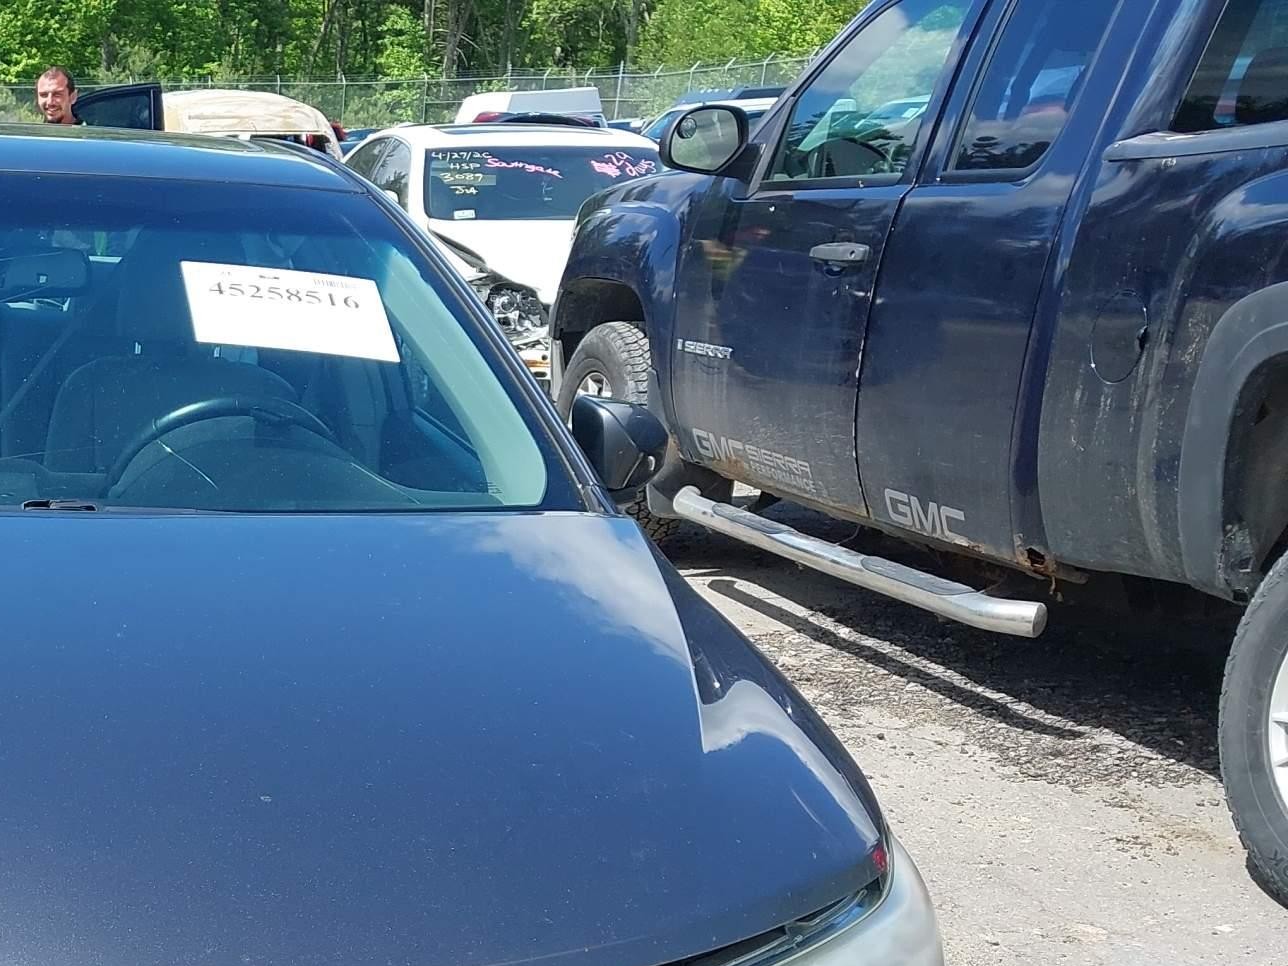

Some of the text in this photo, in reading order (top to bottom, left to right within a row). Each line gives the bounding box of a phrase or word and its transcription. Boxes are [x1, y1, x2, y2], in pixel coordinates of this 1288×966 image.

[209, 281, 360, 310] 45258516
[684, 340, 733, 359] SIERRA
[744, 444, 813, 479] SIERRA
[883, 487, 965, 539] GMC
